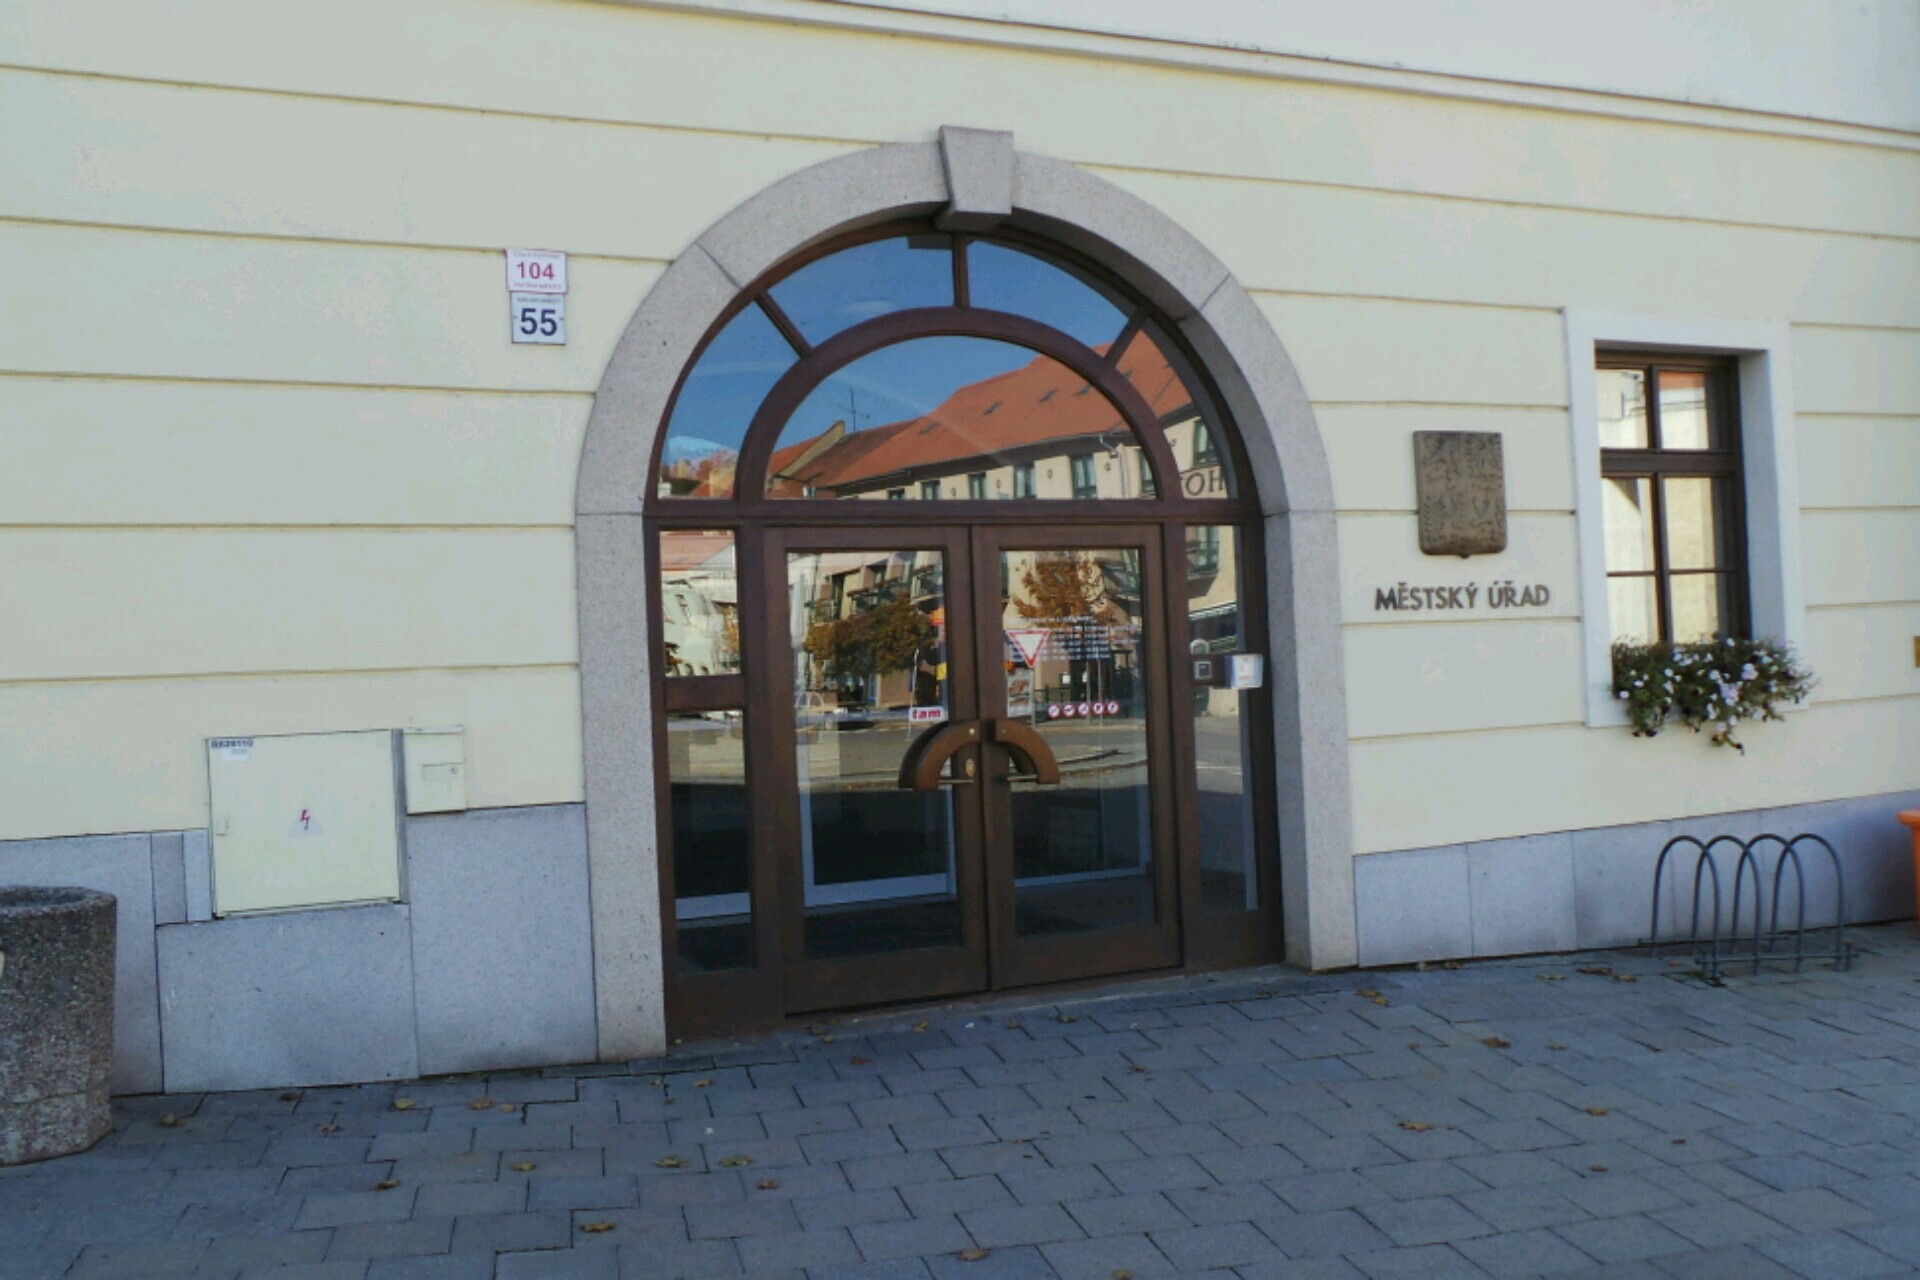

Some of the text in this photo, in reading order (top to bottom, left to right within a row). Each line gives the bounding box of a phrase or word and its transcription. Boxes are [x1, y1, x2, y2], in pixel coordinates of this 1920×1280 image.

[516, 261, 555, 280] 104
[520, 307, 558, 336] 55
[1375, 580, 1551, 611] MĚSTSKÝ ÚŘAD
